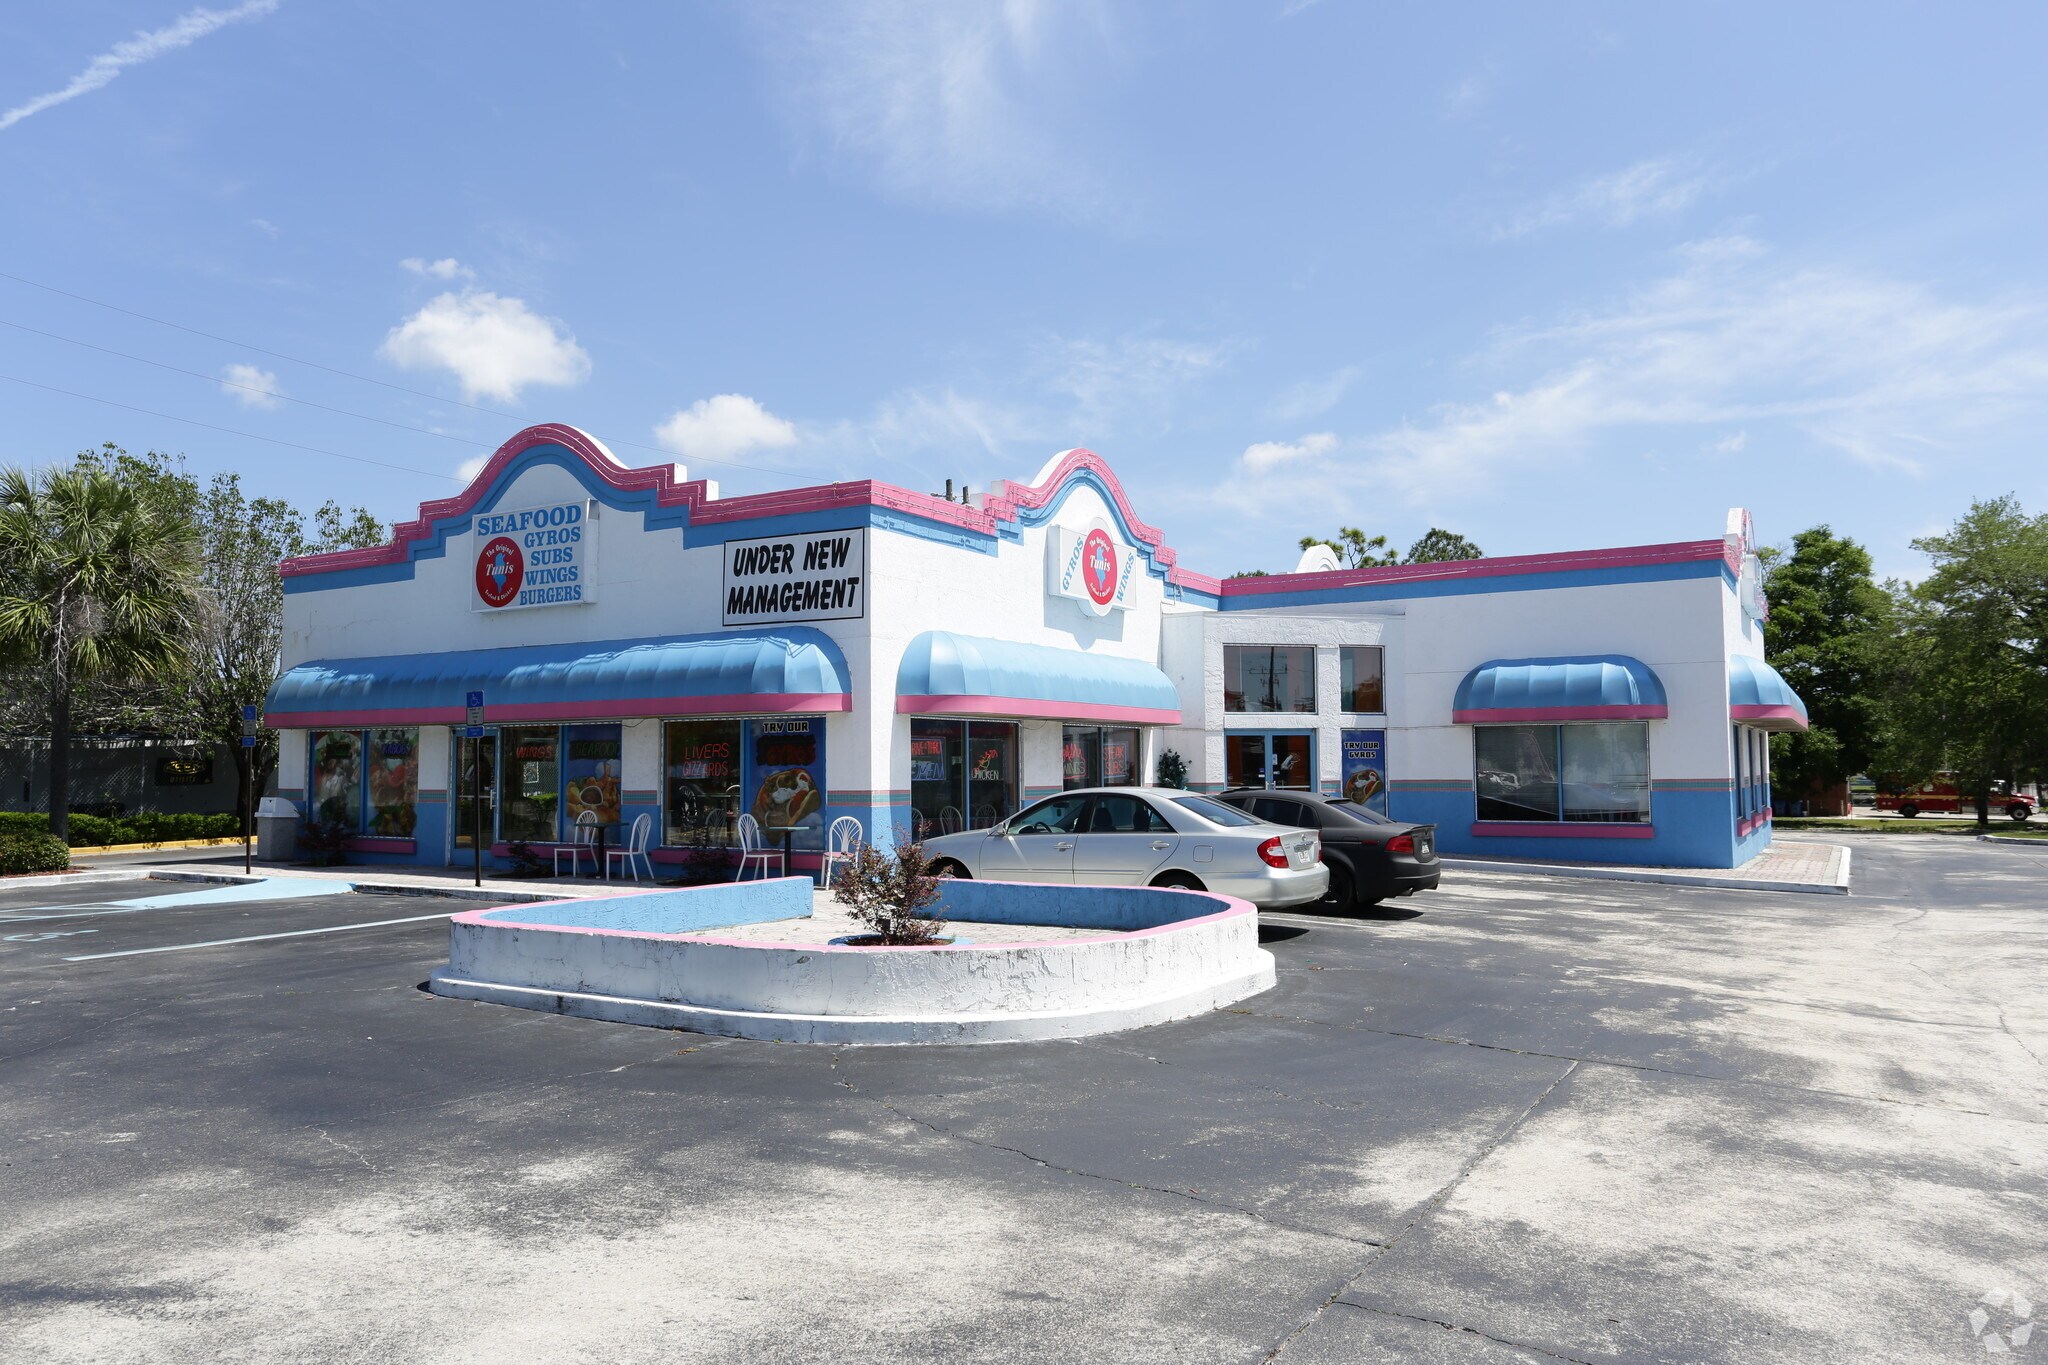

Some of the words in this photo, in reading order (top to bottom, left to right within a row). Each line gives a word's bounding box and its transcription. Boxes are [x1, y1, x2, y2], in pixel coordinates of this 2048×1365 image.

[477, 505, 582, 536] SEAFOOD
[524, 526, 581, 548] GYROS
[486, 549, 495, 557] The
[496, 544, 514, 556] Original
[530, 547, 573, 566] SUBS
[733, 543, 795, 577] UNDER
[803, 537, 851, 571] NEW
[485, 562, 514, 577] Tunis
[1062, 537, 1084, 591] GYROS
[1089, 555, 1110, 571] Tunis
[525, 566, 579, 586] WINGS
[1116, 552, 1134, 601] WINGS
[520, 584, 582, 605] BURGERS
[726, 577, 860, 615] MANAGEMENT
[763, 722, 784, 733] TRY
[786, 721, 810, 733] OUR
[516, 745, 553, 759] WINGS
[685, 742, 729, 759] LIVERS
[1344, 741, 1361, 750] TRY
[1362, 741, 1380, 750] OUR
[1348, 750, 1377, 760] GYROS
[682, 761, 729, 777] GIZZARDS
[971, 767, 999, 781] CHICKEN
